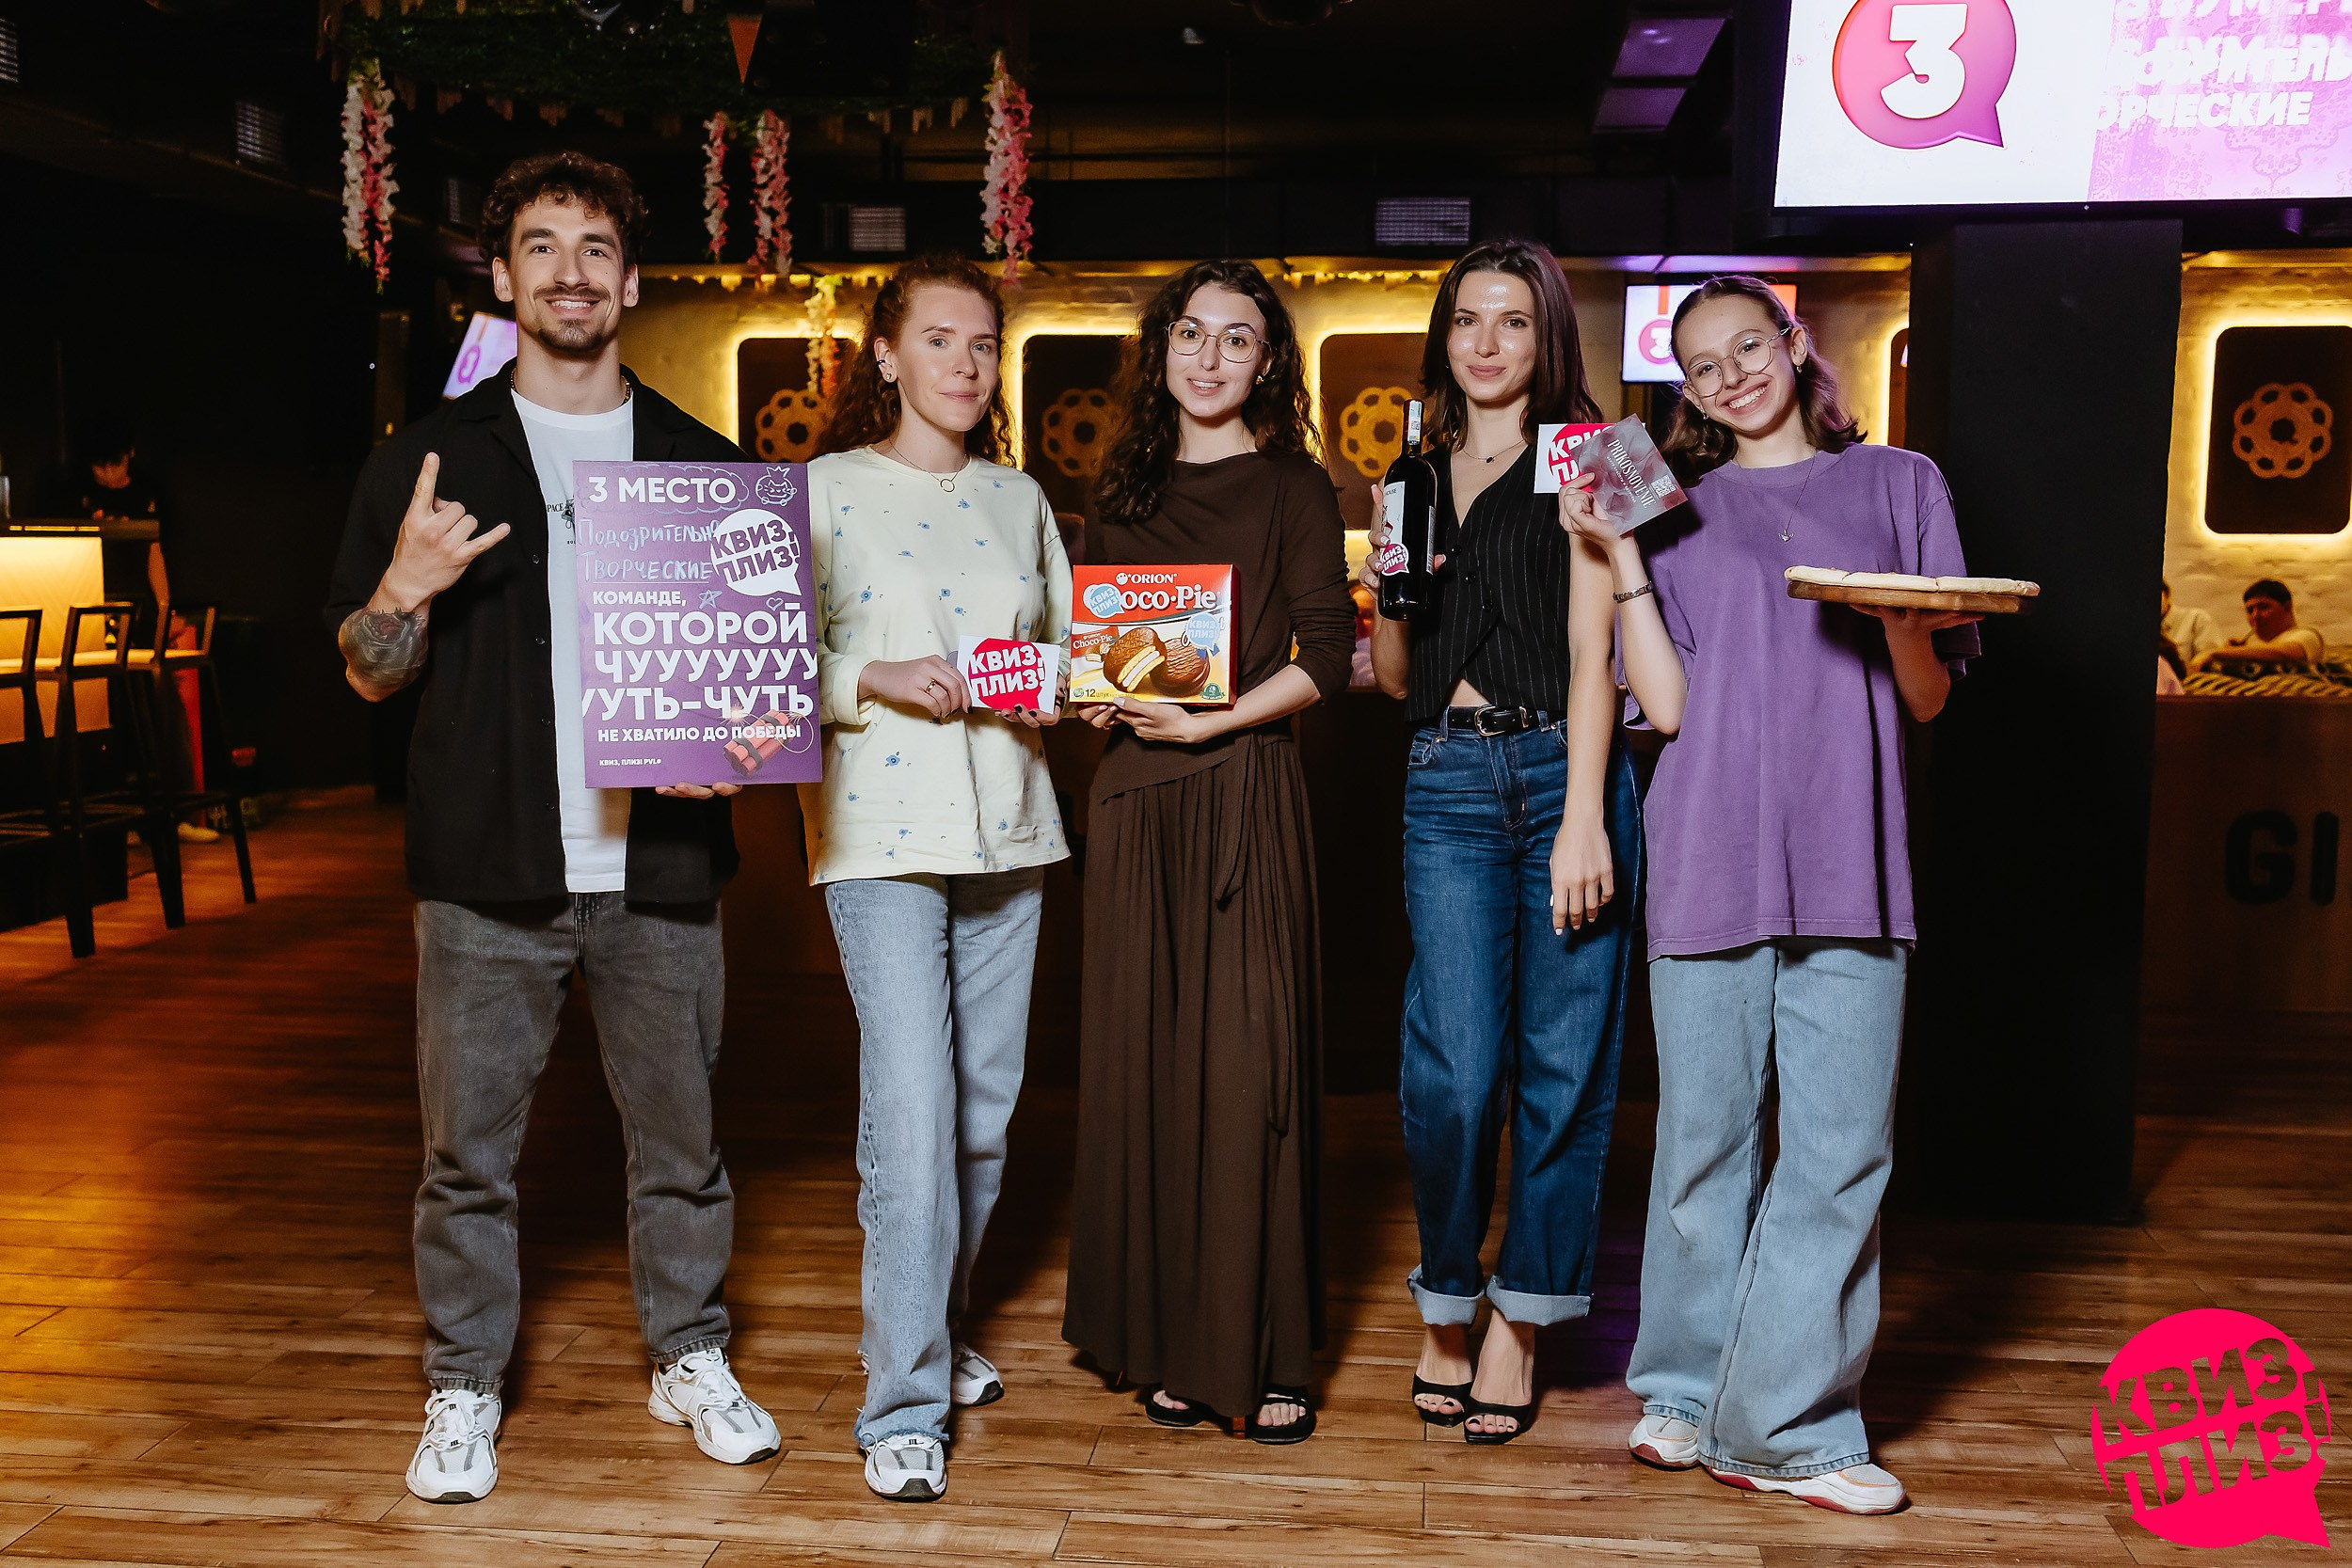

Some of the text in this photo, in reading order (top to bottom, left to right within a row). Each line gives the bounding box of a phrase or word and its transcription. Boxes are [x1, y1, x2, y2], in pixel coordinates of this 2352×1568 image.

[1880, 3, 1968, 119] 3
[1607, 439, 1656, 509] PRIKOSNOVENIE
[589, 477, 736, 504] 3 МЕСТО
[716, 543, 800, 583] ПЛИЗ!
[1131, 573, 1174, 584] ORION
[593, 591, 687, 607] КОМАНДЕ,
[594, 602, 807, 645] КОТОРОЙ
[595, 648, 818, 684] ЧУУУУУУУ
[1086, 689, 1096, 698] 12
[597, 724, 802, 742] НЕ ХВАТИЛО ДО ПОБЕДЫ
